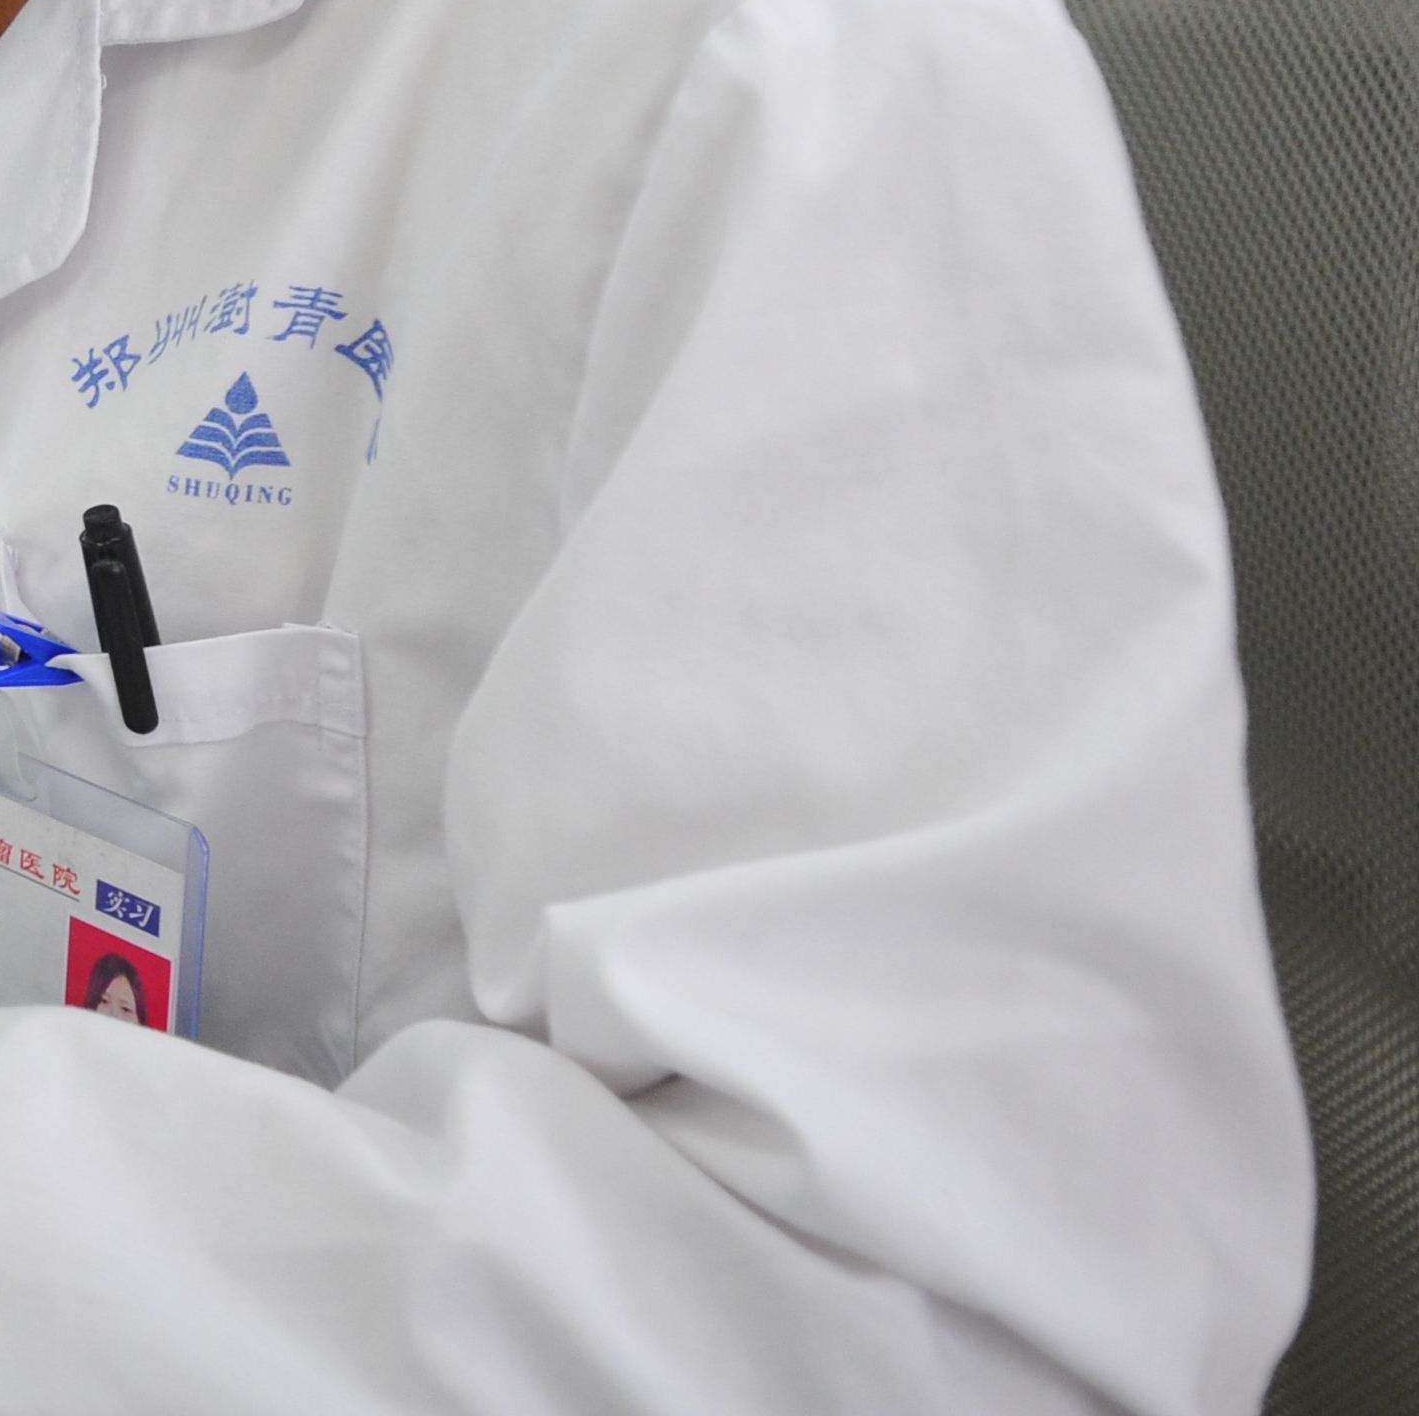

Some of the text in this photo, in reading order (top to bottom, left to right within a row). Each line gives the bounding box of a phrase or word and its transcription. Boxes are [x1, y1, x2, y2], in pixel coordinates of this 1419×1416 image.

[70, 280, 394, 466] 郑州澍青医
[166, 474, 293, 506] SHUQING
[105, 890, 153, 928] 实习
